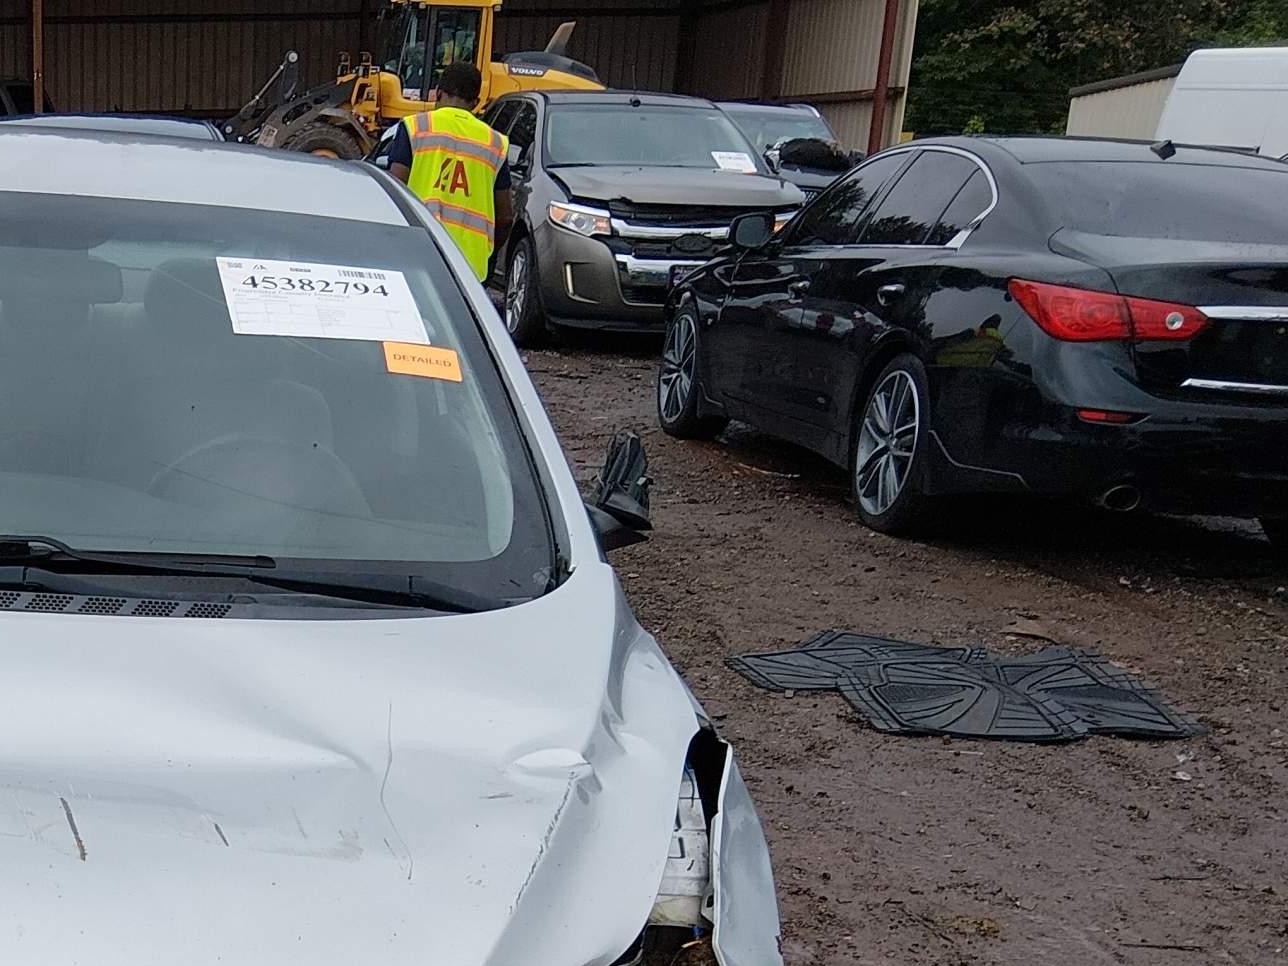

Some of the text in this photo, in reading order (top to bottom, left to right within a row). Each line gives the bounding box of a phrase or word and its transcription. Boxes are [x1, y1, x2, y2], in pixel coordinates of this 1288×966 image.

[511, 67, 544, 76] VOLVO
[242, 275, 389, 297] 45382794
[392, 353, 452, 368] DETAILED
